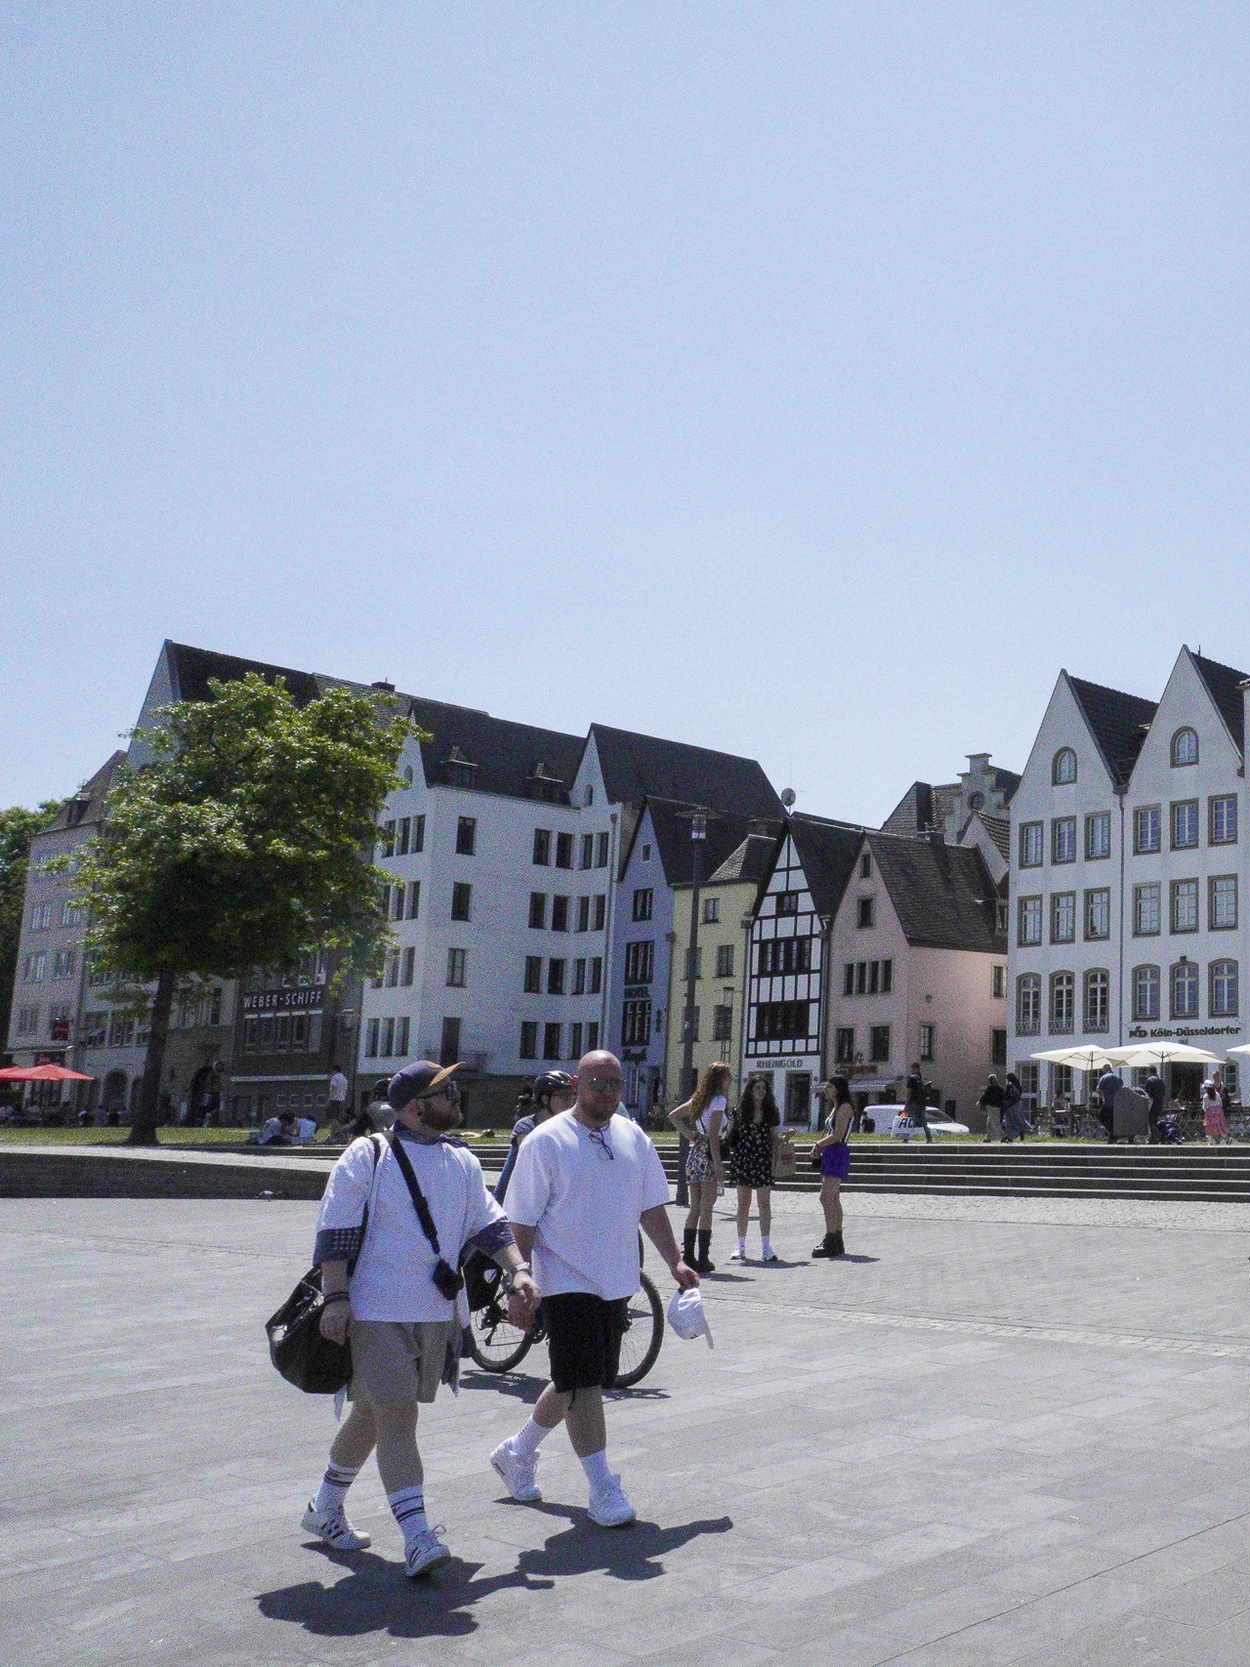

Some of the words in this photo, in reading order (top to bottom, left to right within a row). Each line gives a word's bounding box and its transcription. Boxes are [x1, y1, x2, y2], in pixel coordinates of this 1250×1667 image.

[243, 991, 322, 1008] WEBER-SCHIFF
[1150, 1026, 1241, 1038] Köln-Düsseldorfer
[756, 1060, 803, 1069] RHEINGOLD
